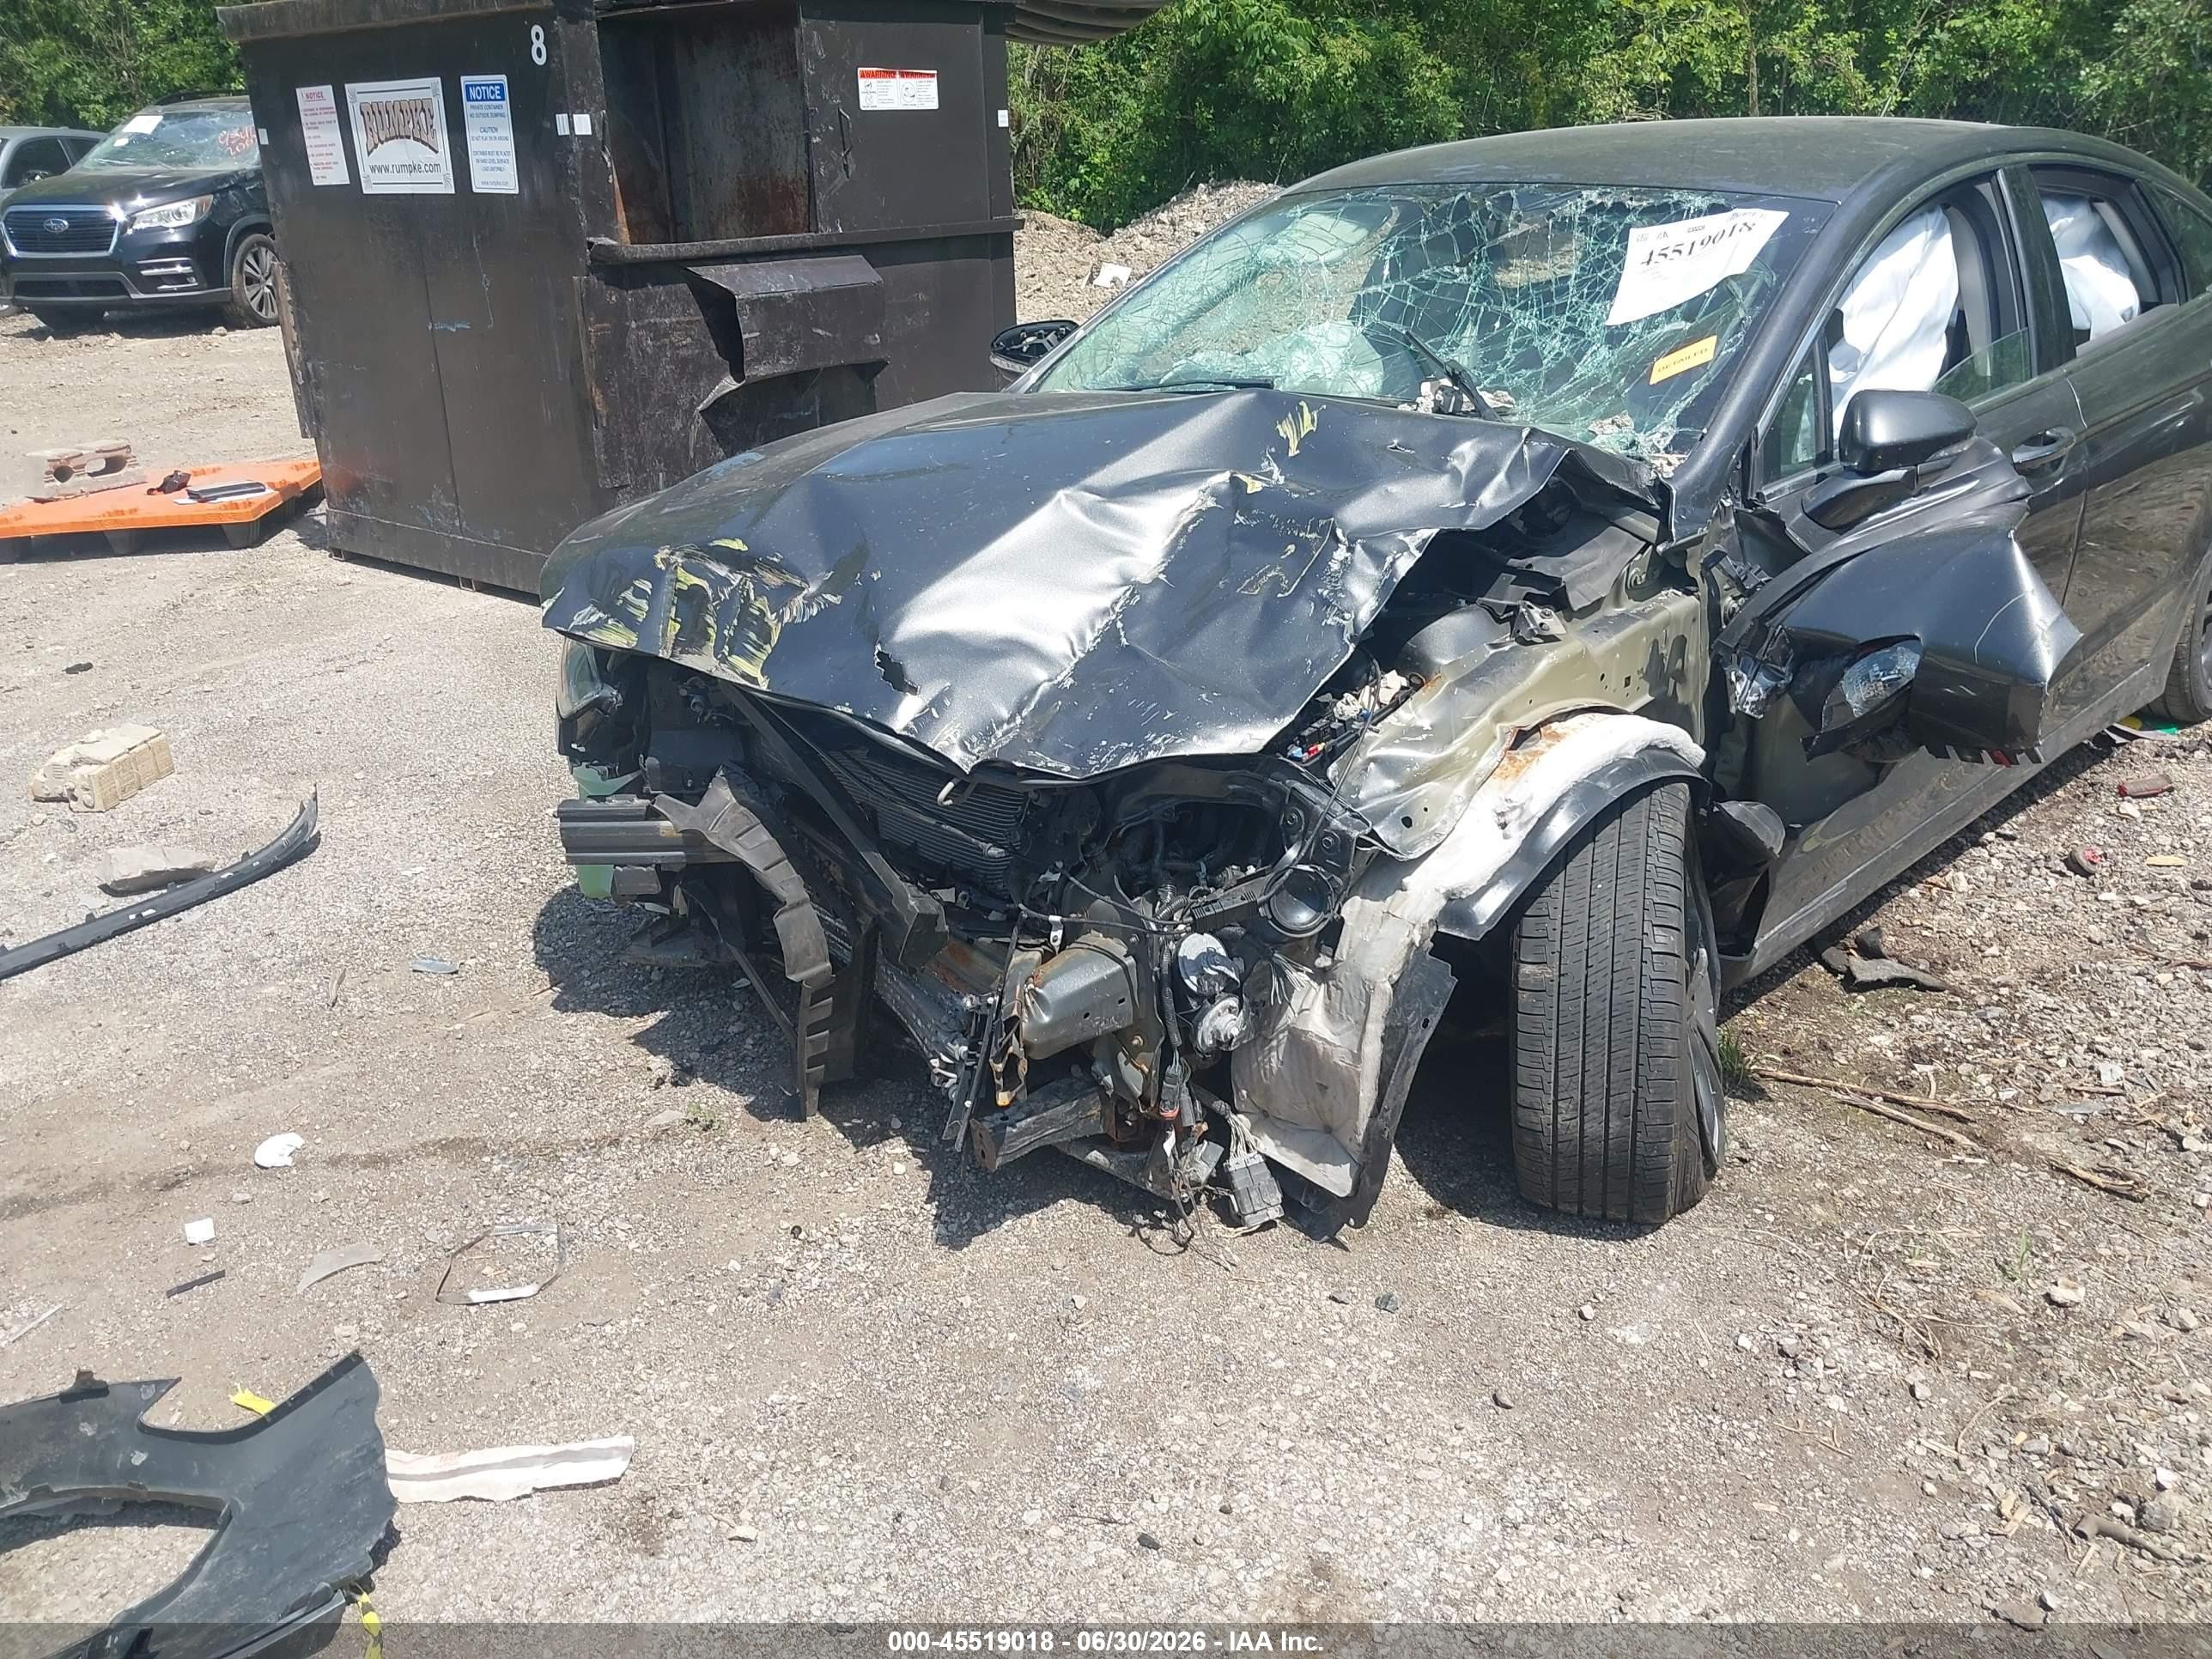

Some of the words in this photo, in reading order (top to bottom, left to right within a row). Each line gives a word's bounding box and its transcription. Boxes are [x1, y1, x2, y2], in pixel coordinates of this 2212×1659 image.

[530, 23, 548, 66] 8
[305, 91, 324, 100] NOTICE
[469, 85, 501, 100] NOTICE
[360, 97, 439, 157] RUMPKE
[368, 160, 442, 178] www.rumpke.com
[1639, 221, 1757, 267] 45519018
